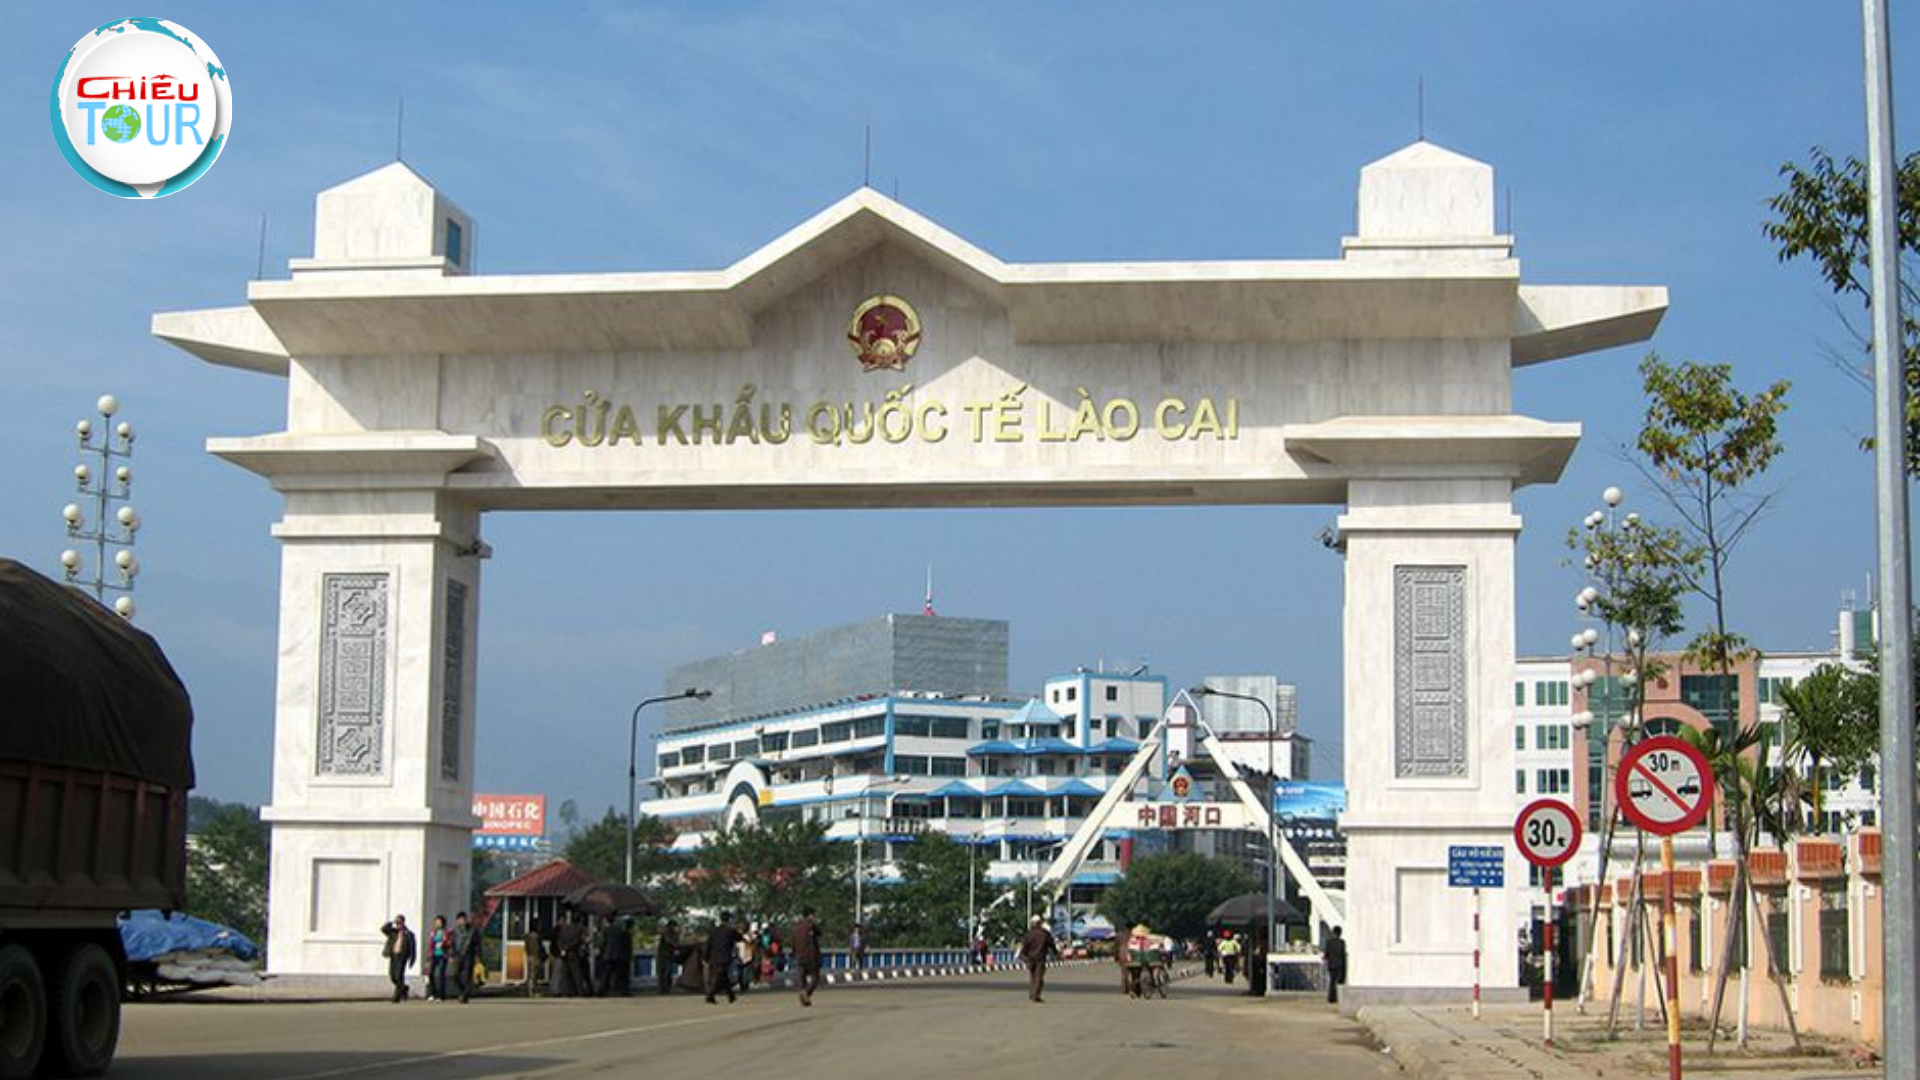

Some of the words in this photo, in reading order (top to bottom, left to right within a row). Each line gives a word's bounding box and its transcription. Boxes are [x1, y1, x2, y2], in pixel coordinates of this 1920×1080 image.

[541, 389, 642, 447] CỬA
[657, 384, 792, 445] KHẨU
[806, 384, 948, 446] QUỐC
[964, 384, 1028, 443] TẾ
[1037, 386, 1141, 442] LÀO
[1154, 397, 1240, 442] CAI
